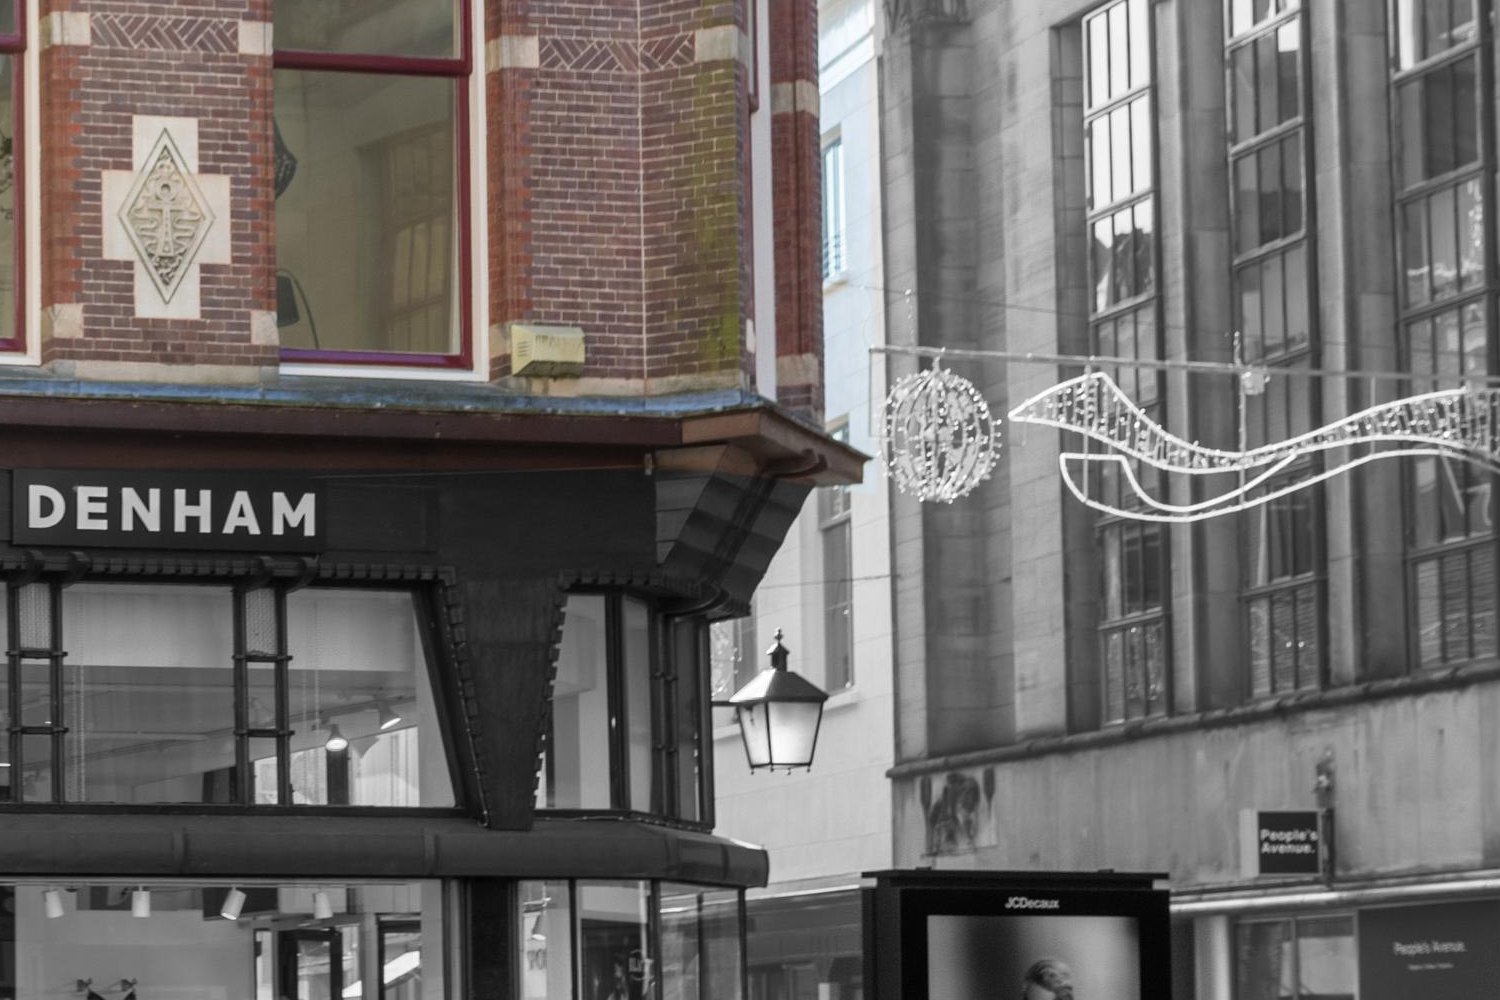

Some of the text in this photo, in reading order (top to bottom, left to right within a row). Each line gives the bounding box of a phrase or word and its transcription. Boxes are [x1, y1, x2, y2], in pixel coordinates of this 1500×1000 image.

[28, 484, 316, 537] DENHAM
[1260, 828, 1318, 843] People's
[1261, 842, 1316, 854] Avenue.
[1004, 896, 1060, 909] JCDecaux
